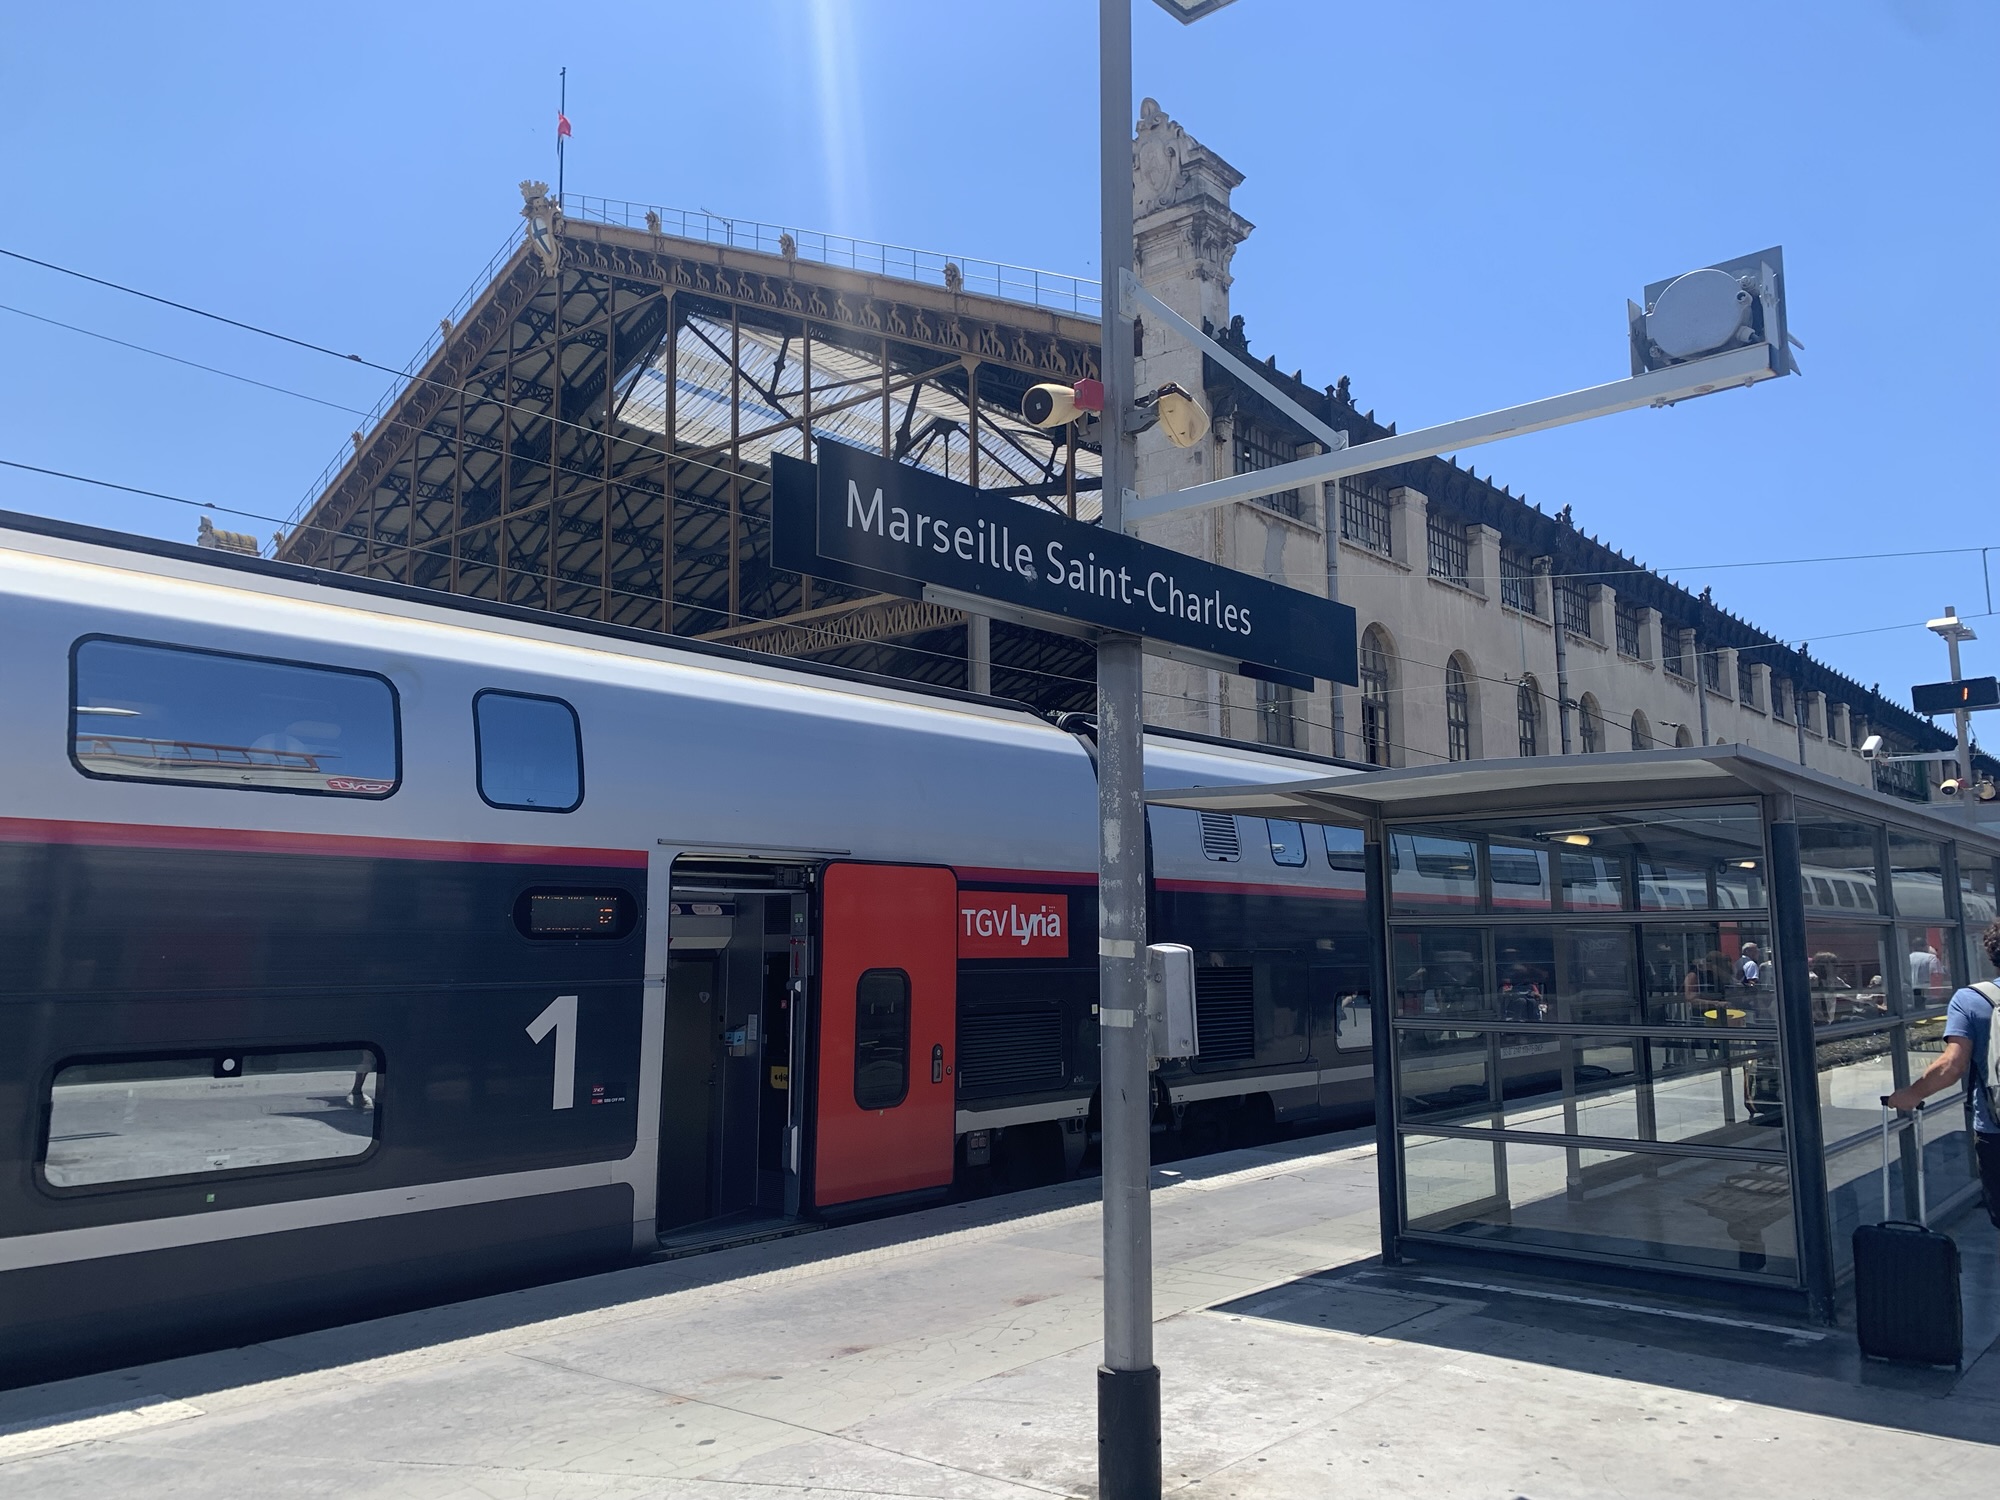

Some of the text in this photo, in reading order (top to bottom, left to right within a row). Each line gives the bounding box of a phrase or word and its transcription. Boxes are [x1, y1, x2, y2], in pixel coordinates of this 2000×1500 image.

[846, 478, 1253, 636] Marseille Saint-Charles
[961, 904, 1061, 946] TGV Lyria
[526, 995, 578, 1110] 1
